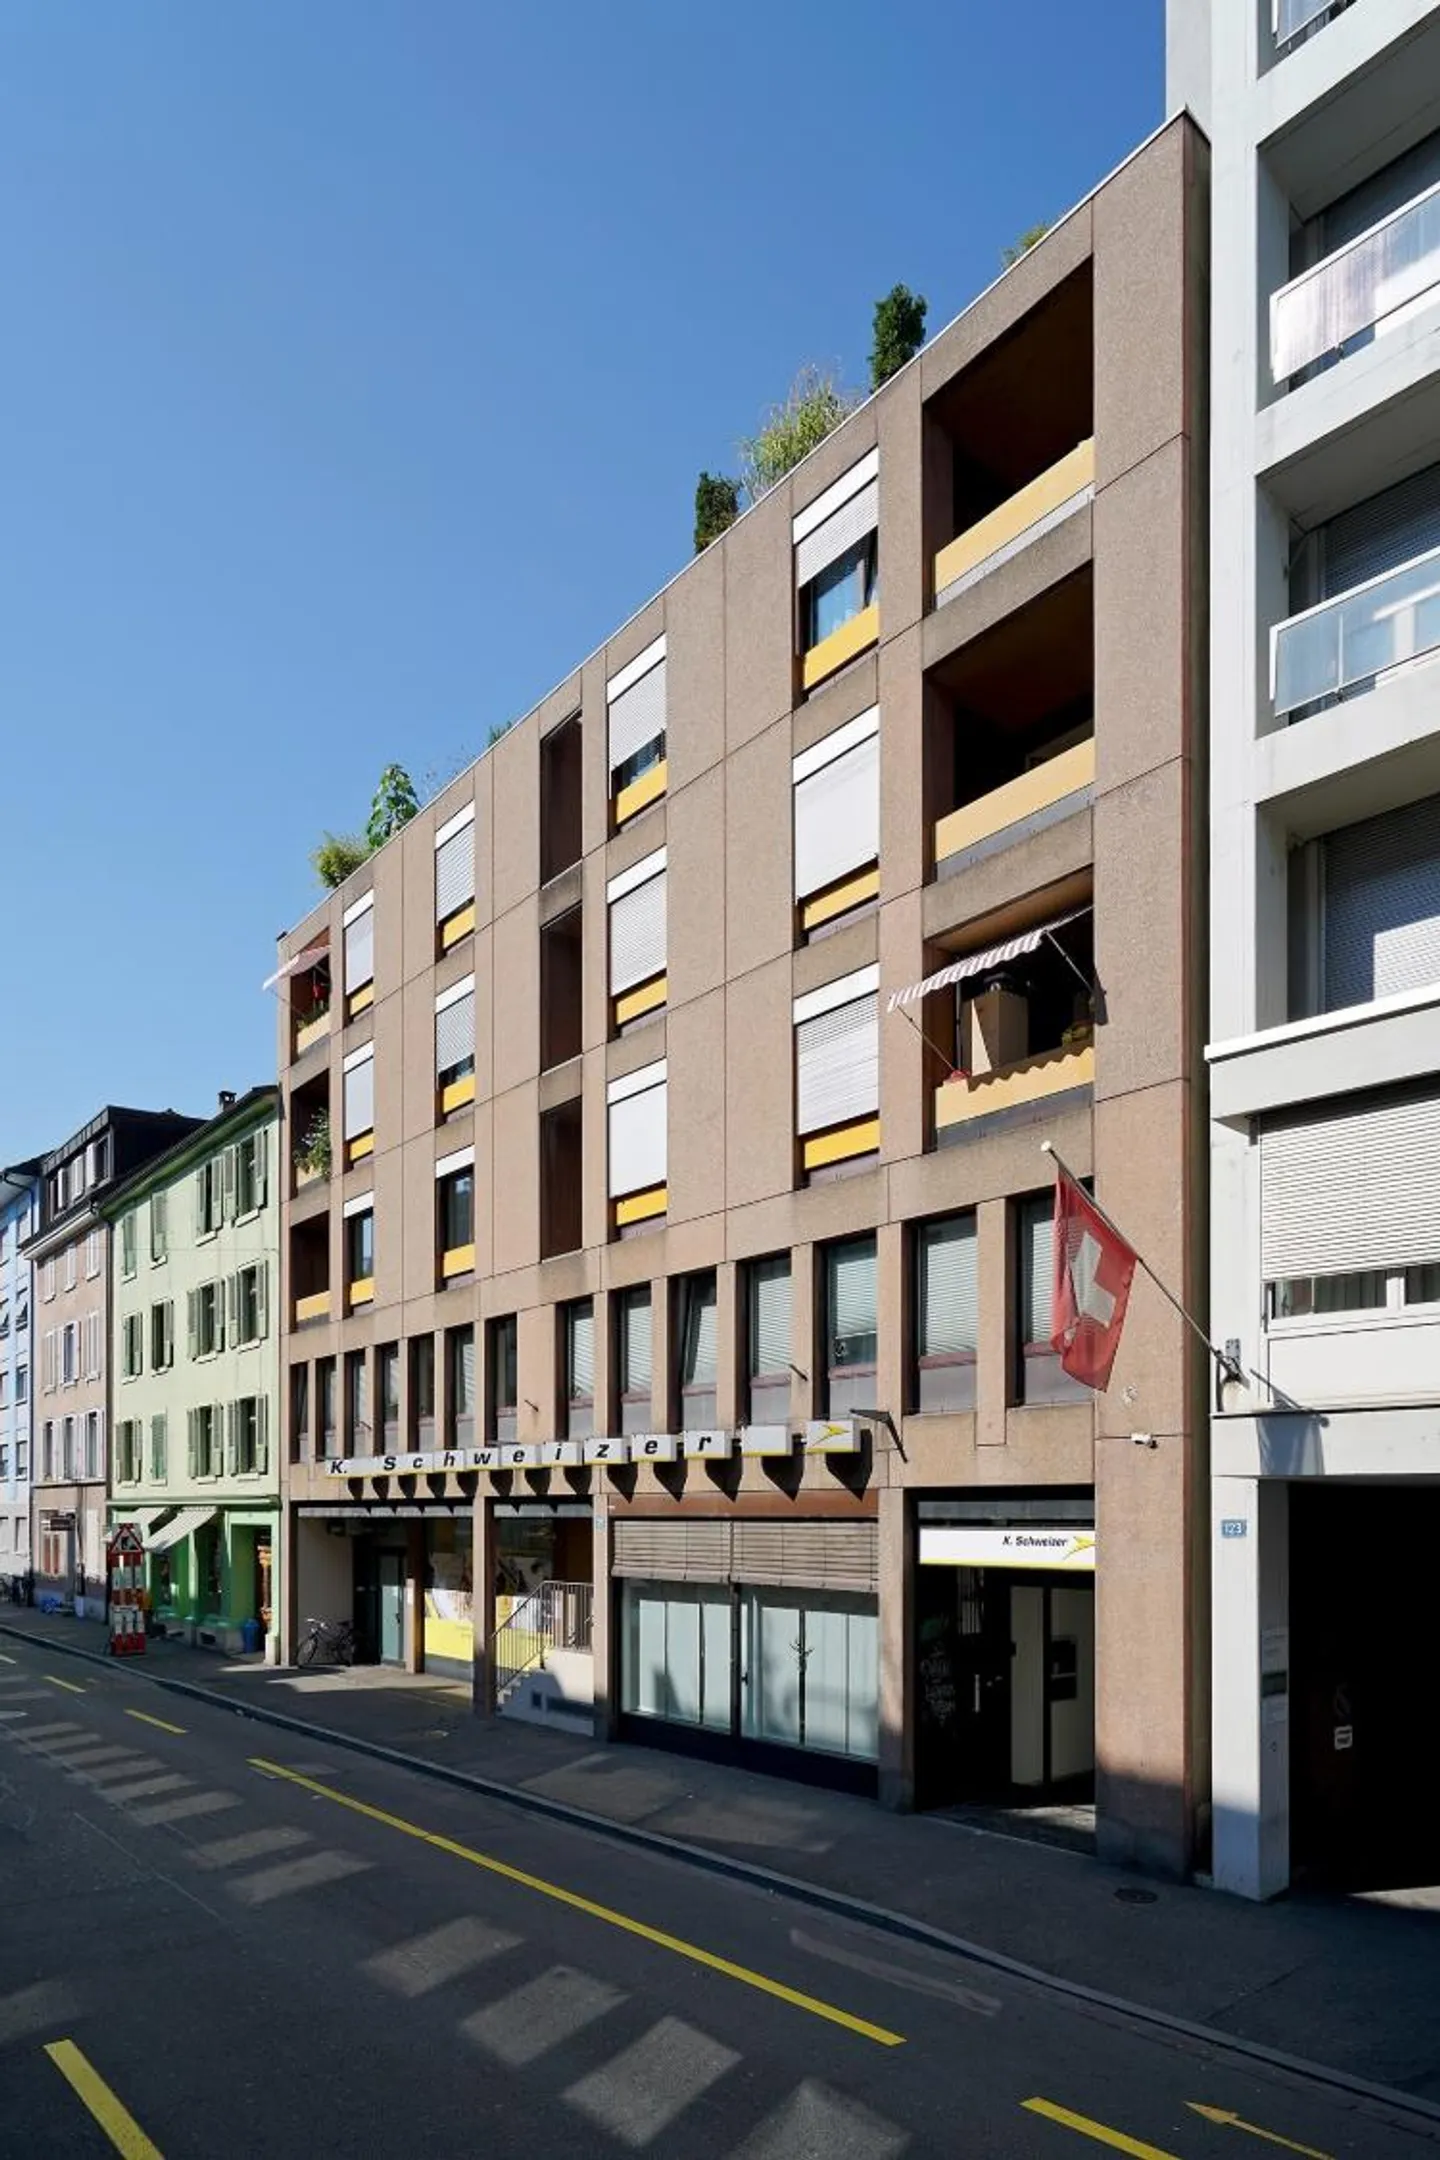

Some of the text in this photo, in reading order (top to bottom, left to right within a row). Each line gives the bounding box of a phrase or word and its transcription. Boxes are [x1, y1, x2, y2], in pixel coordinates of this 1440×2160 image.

[330, 1435, 711, 1474] K. Schweizer
[1002, 1536, 1068, 1547] K. Schweizer
